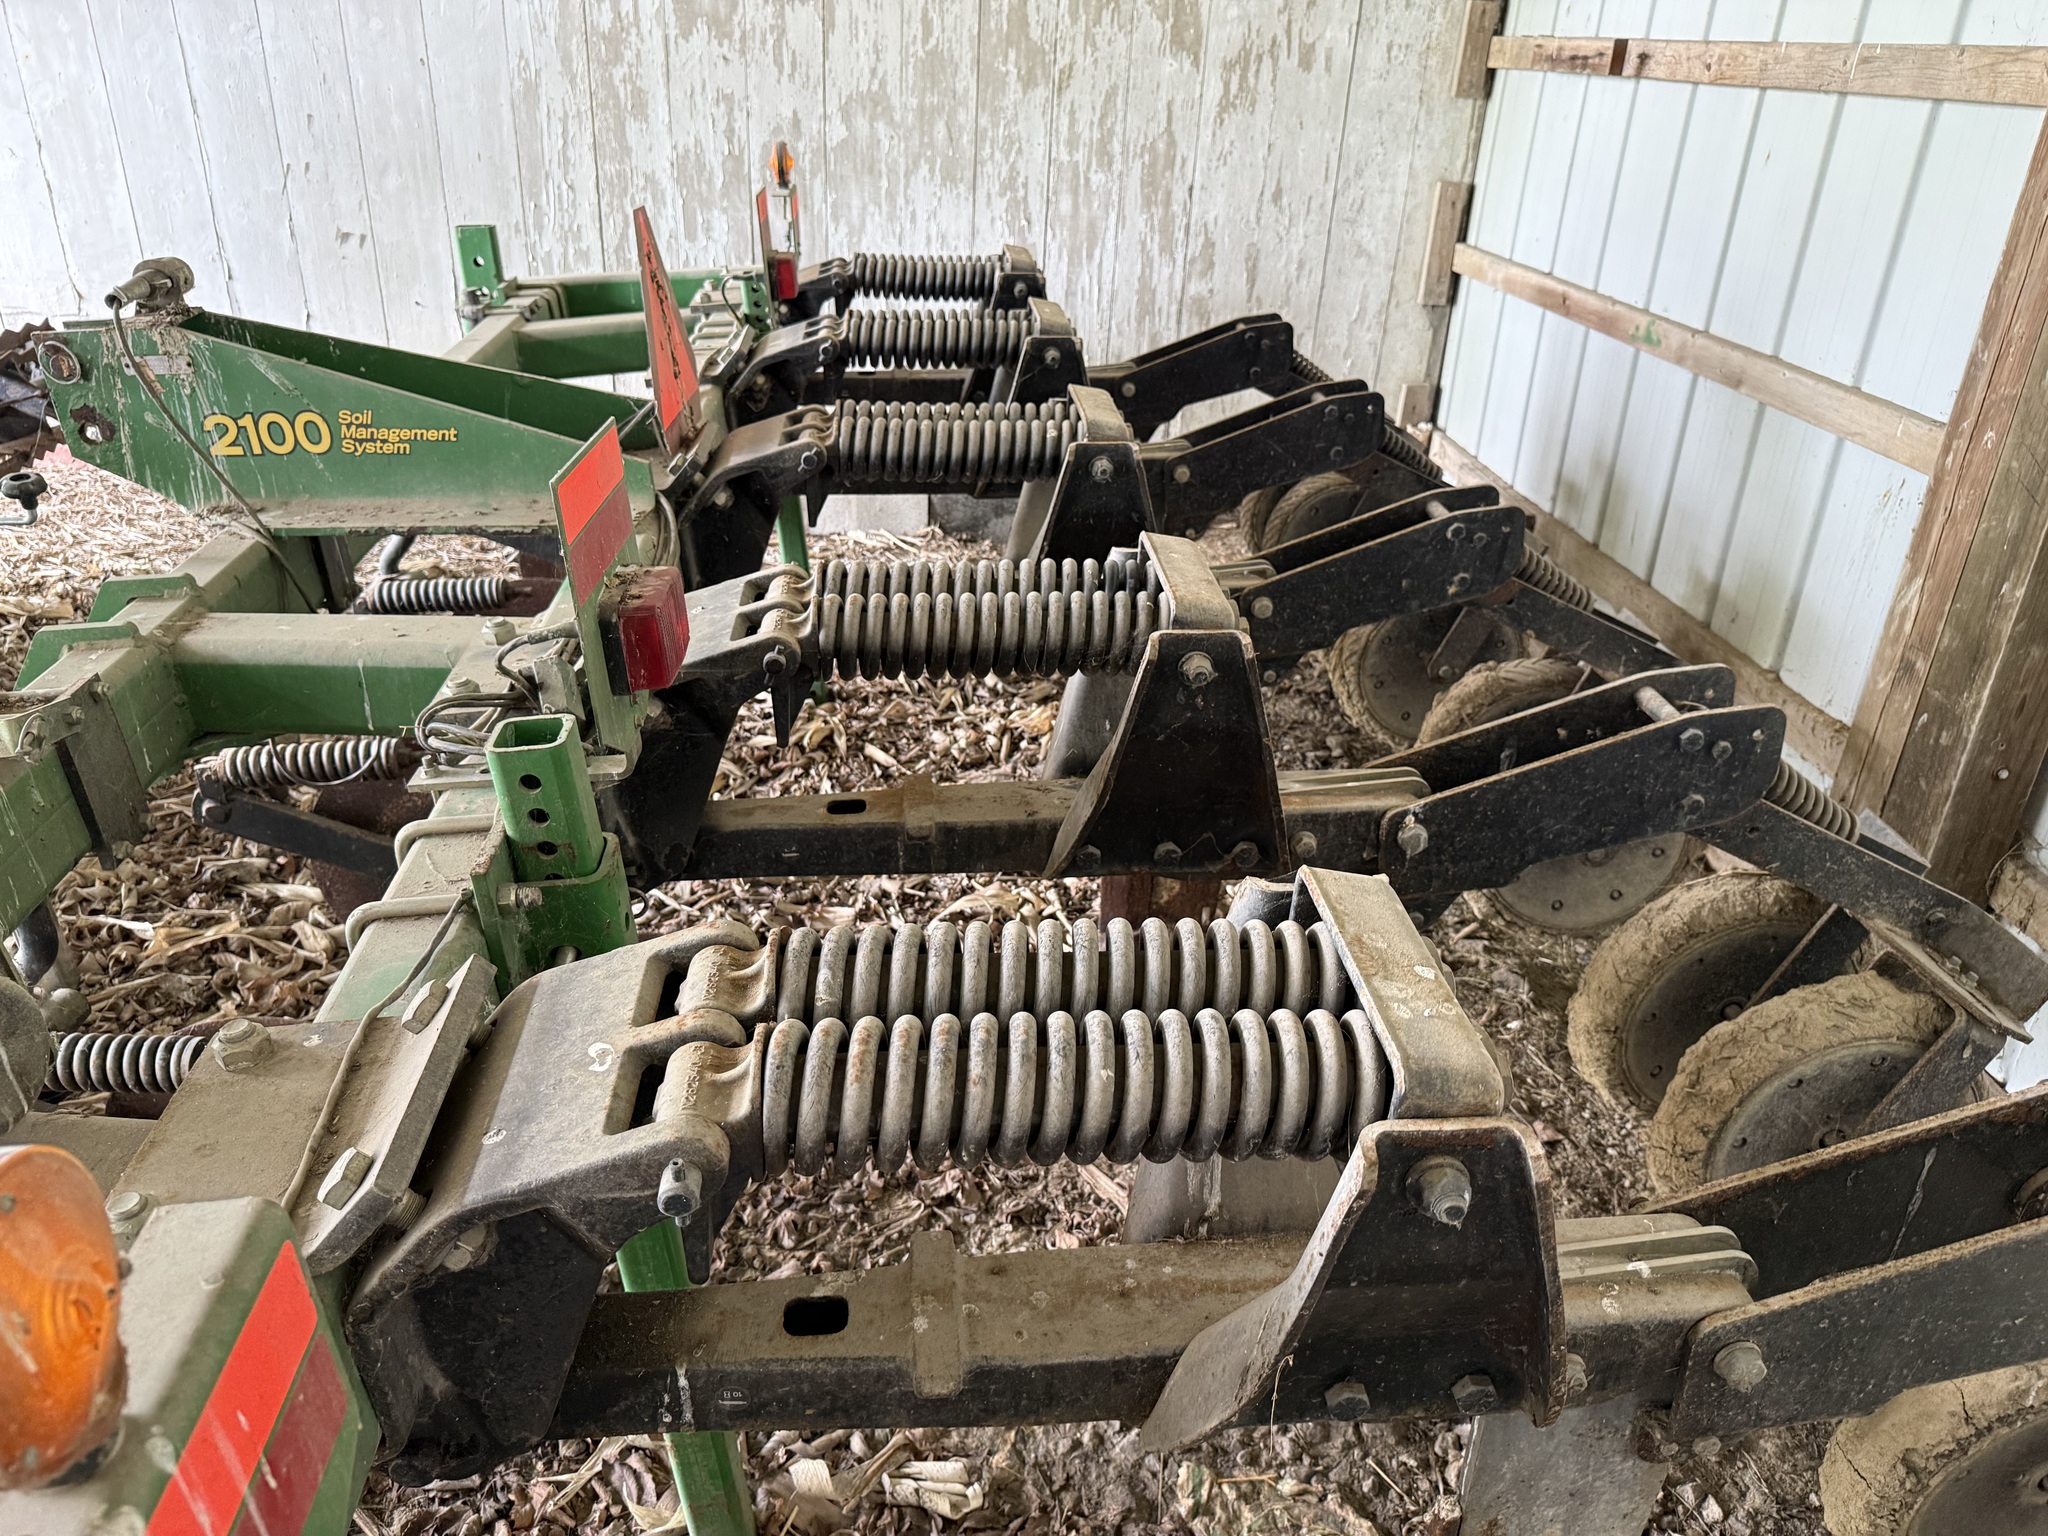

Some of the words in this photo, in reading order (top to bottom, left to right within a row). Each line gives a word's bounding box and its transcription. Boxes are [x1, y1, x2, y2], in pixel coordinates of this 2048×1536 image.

[338, 409, 373, 425] Soil
[203, 411, 332, 456] 2100
[340, 424, 458, 442] Management
[341, 440, 411, 456] System
